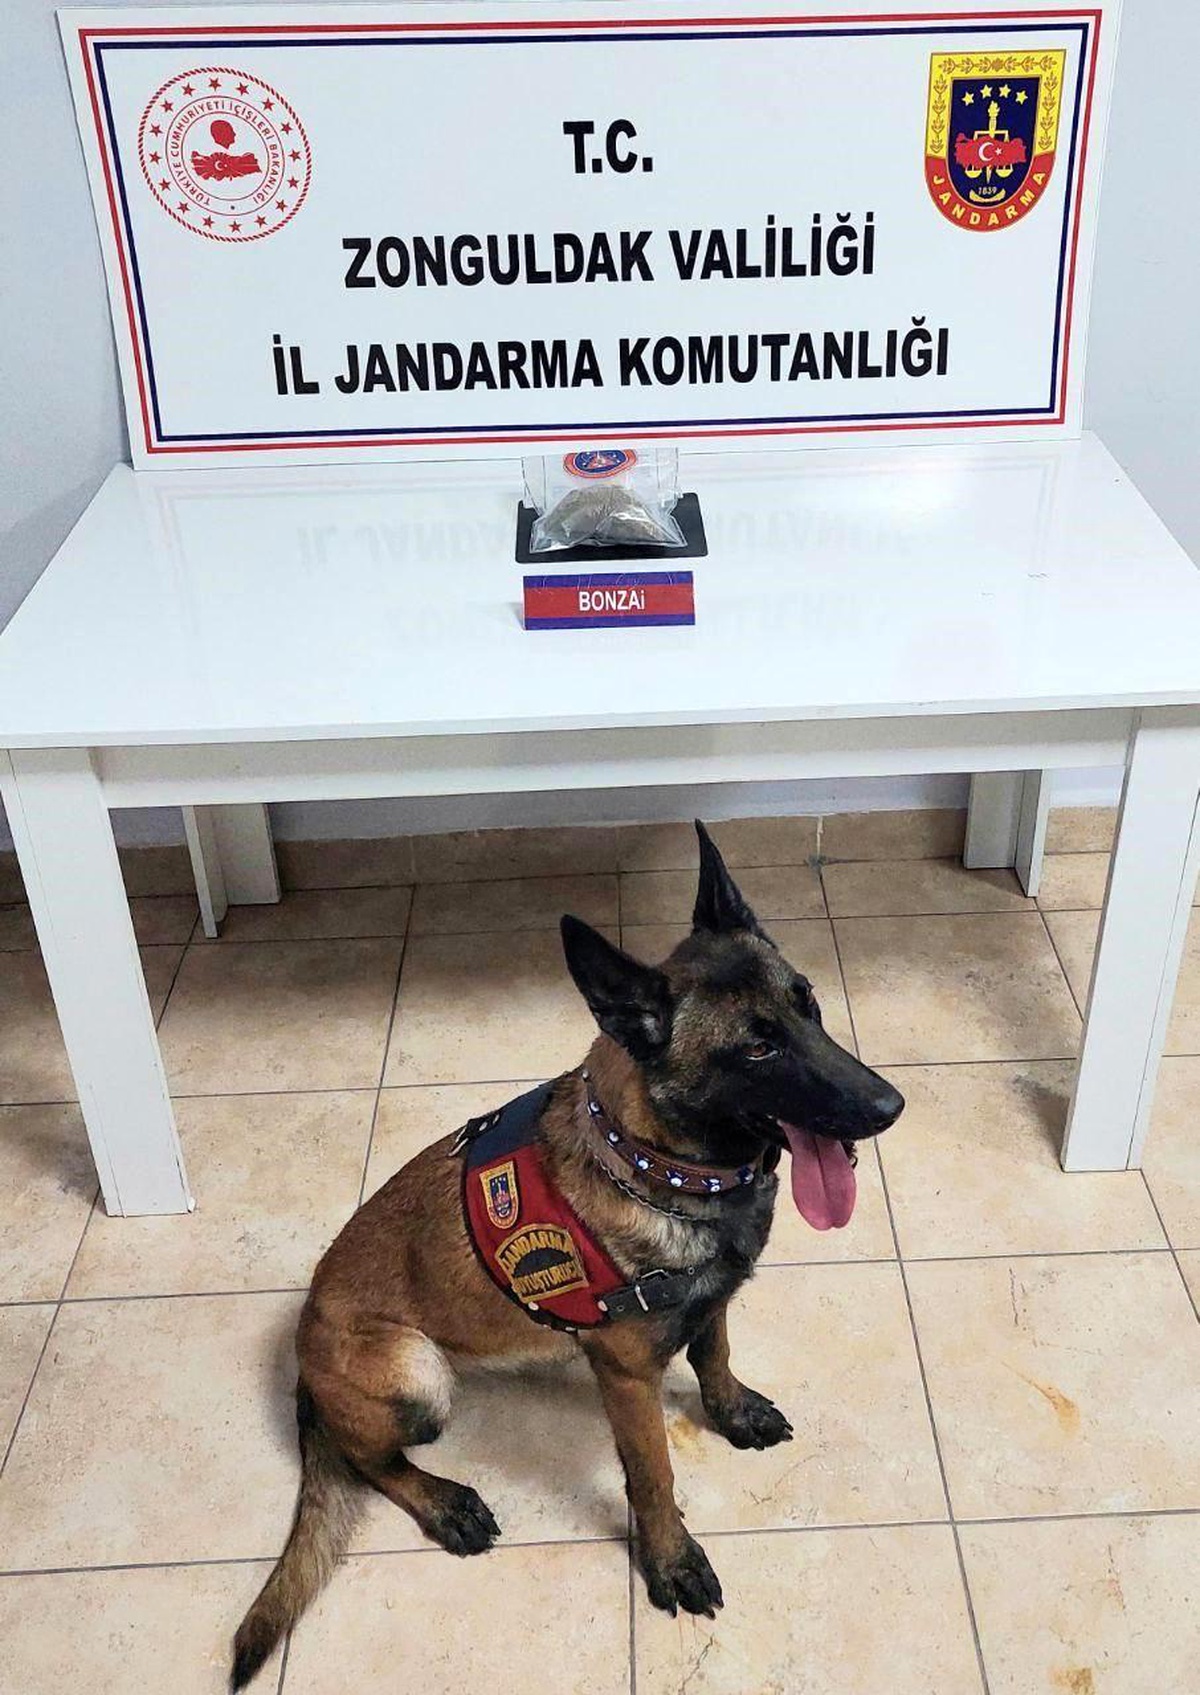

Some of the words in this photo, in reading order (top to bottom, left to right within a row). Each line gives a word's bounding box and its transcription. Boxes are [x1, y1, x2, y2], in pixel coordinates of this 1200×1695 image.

[170, 100, 225, 158] CUMHURİYETİ
[229, 99, 275, 141] İÇİŞLERİ
[562, 118, 654, 174] T.C.
[172, 161, 212, 206] TÜRKİYE
[252, 143, 281, 205] BAKANLIĞI
[933, 172, 1045, 226] JANDARMA
[978, 186, 997, 195] 1839
[342, 230, 655, 288] ZONGULDAK
[669, 211, 875, 282] VALİLİĞİ
[272, 333, 320, 396] İL
[334, 338, 604, 394] JANDARMA
[619, 316, 950, 388] KOMUTANLIĞI
